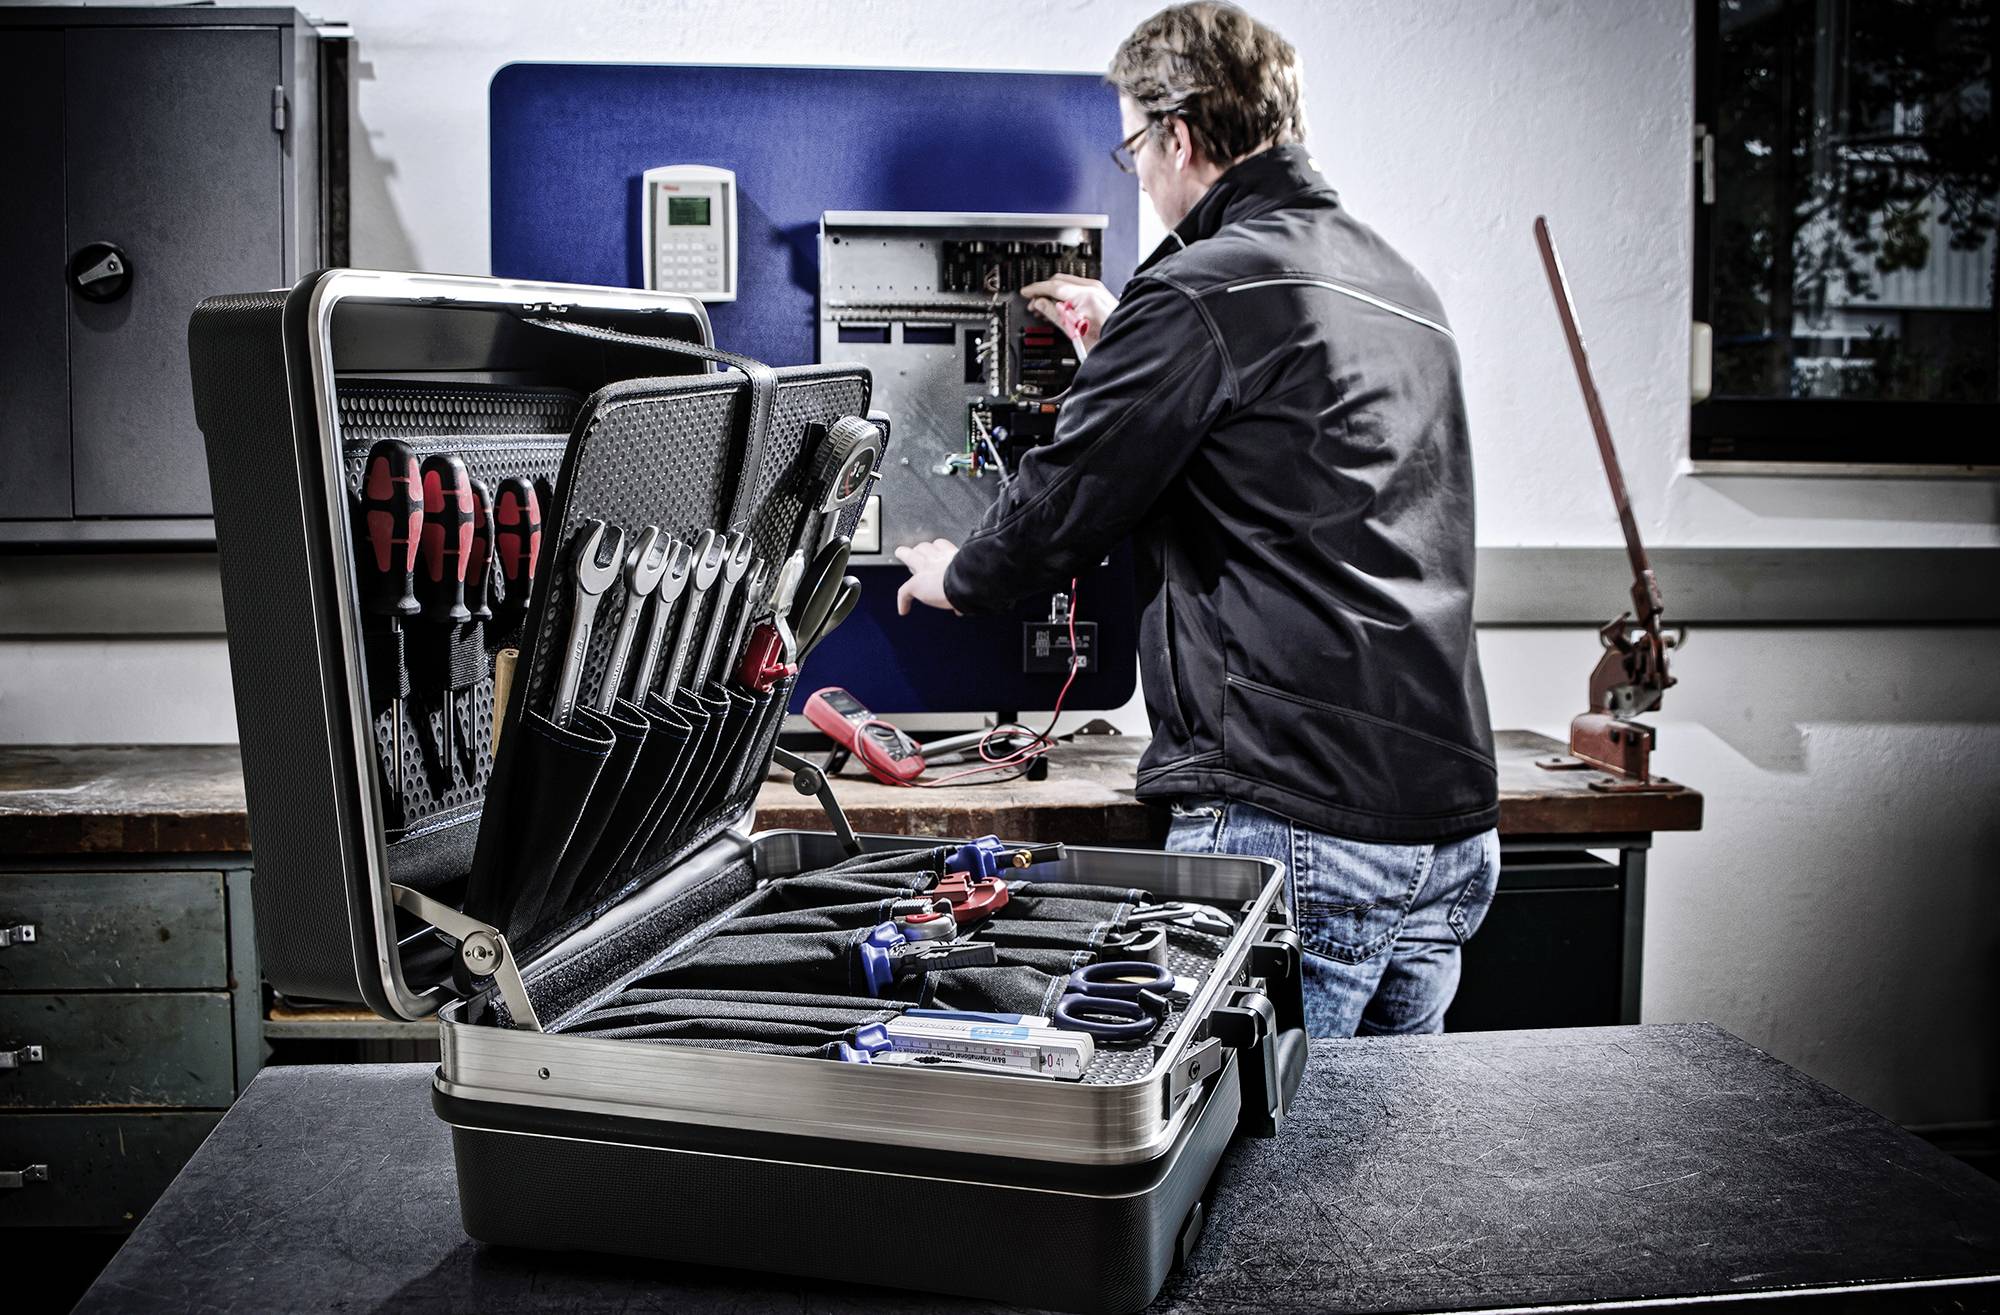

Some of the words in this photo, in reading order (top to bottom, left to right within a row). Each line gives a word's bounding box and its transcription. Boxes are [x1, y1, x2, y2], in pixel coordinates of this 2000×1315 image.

[955, 1053, 990, 1062] International
[991, 1056, 1006, 1064] B&W
[1047, 1053, 1053, 1067] 0
[1056, 1057, 1064, 1068] 41
